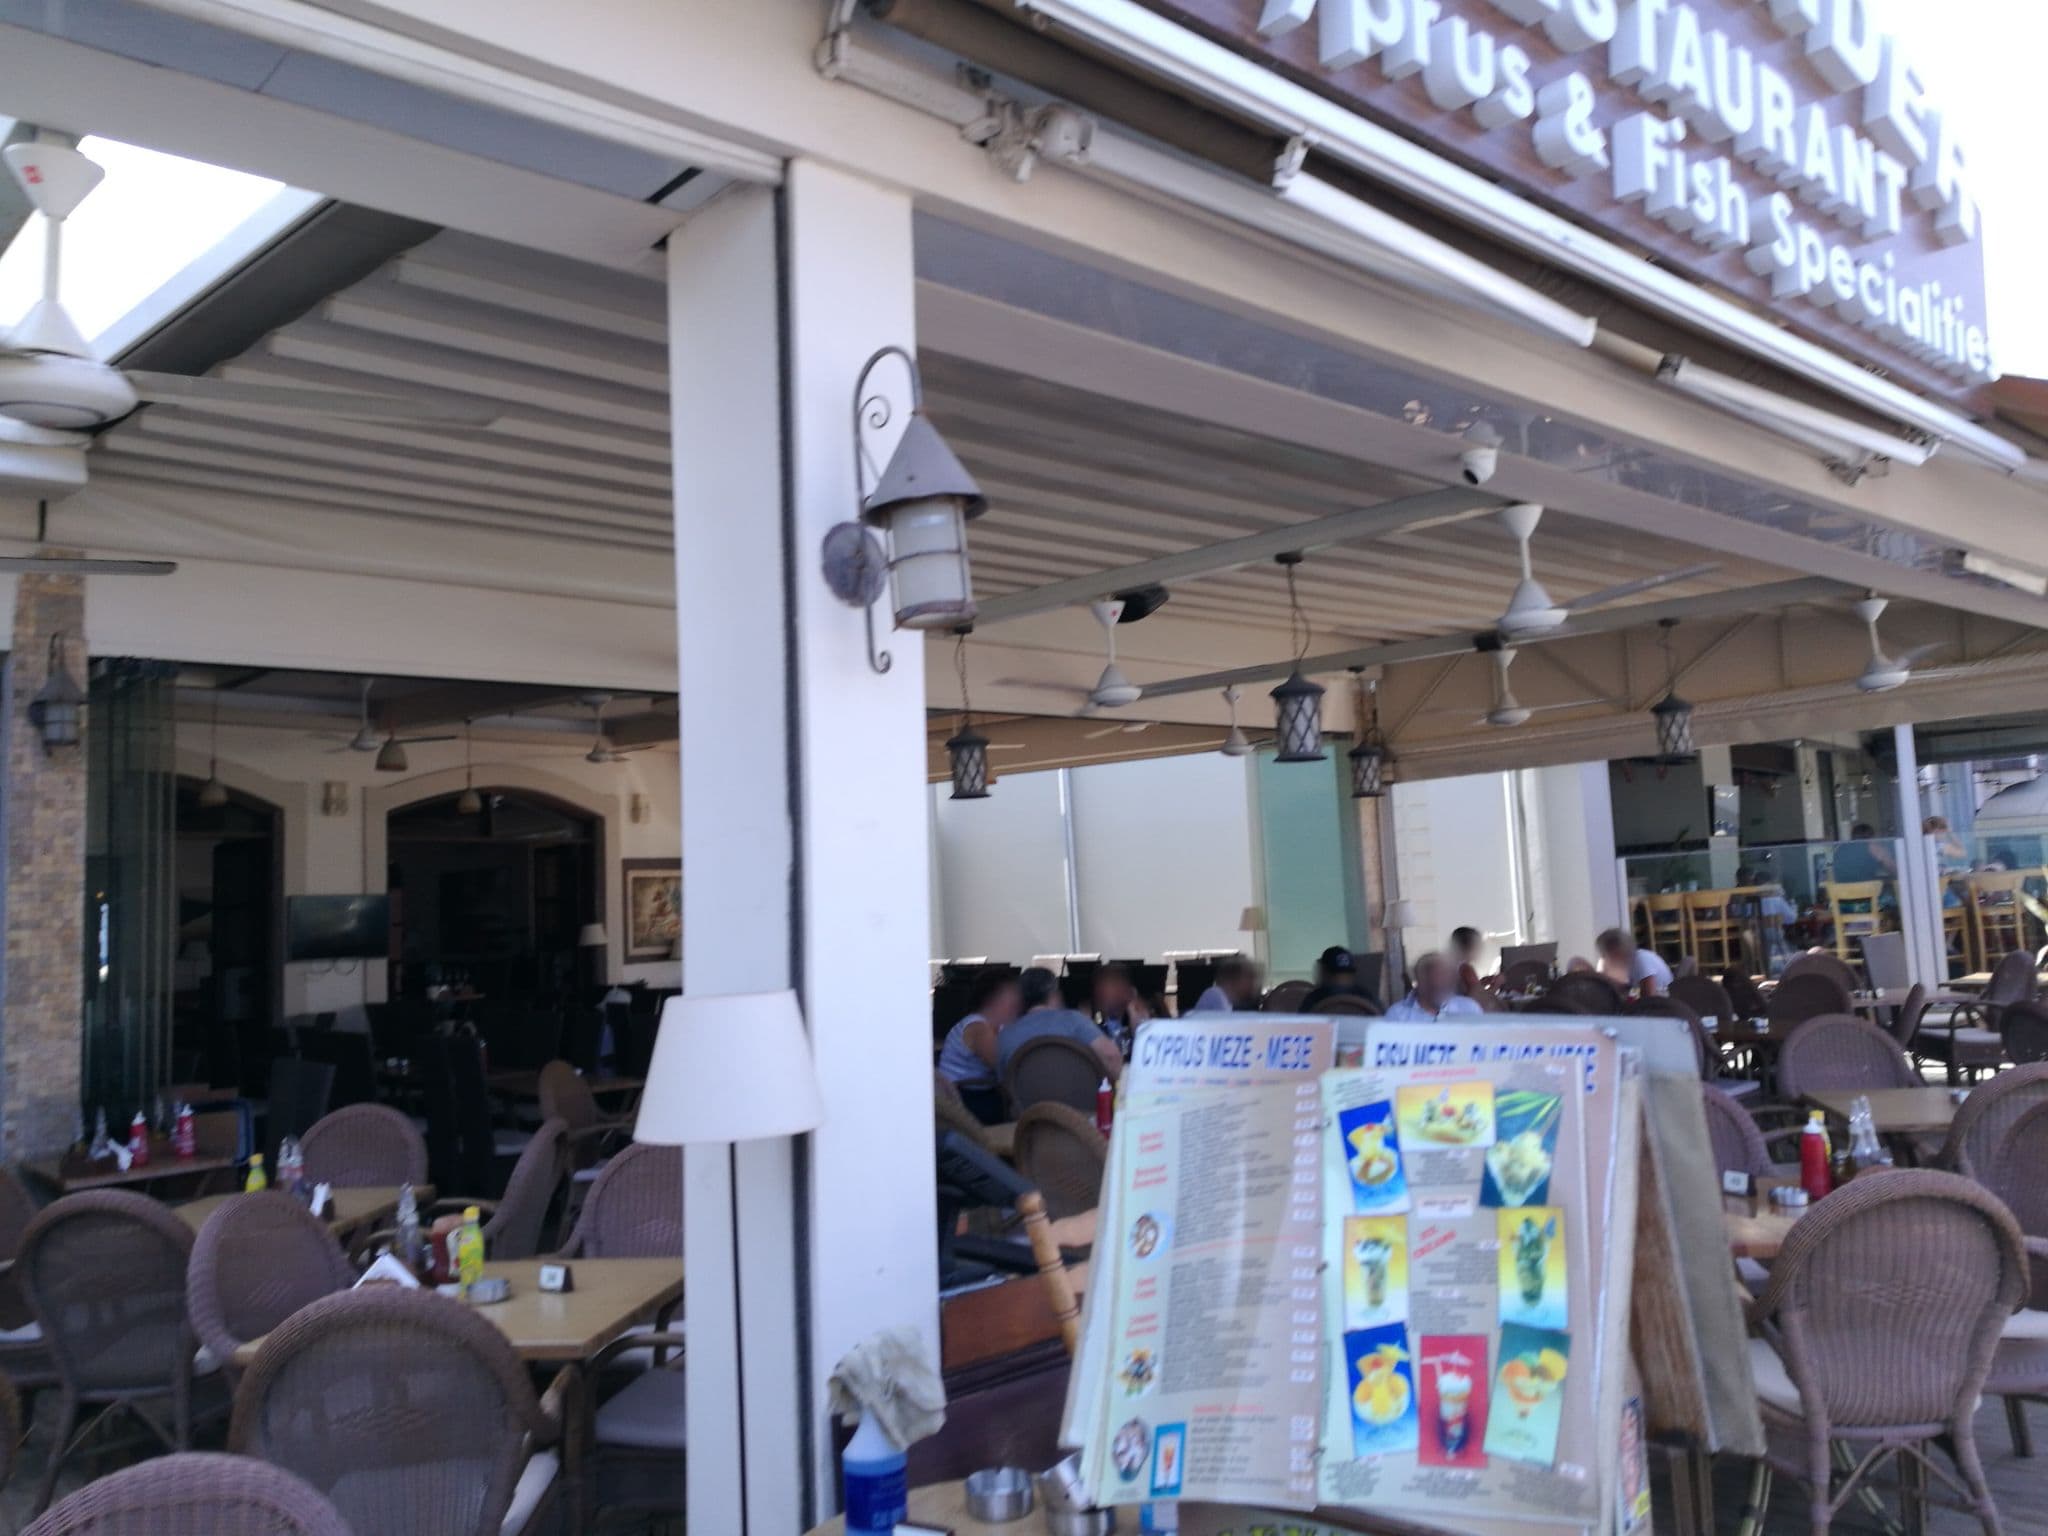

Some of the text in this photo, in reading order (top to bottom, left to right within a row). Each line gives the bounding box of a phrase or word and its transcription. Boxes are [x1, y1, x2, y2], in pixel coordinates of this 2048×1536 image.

[1560, 71, 1610, 168] &
[1638, 112, 1749, 247] Fish
[1795, 0, 1976, 243] DER
[1143, 1035, 1206, 1068] CYPRUS
[1207, 1036, 1255, 1070] MEZE
